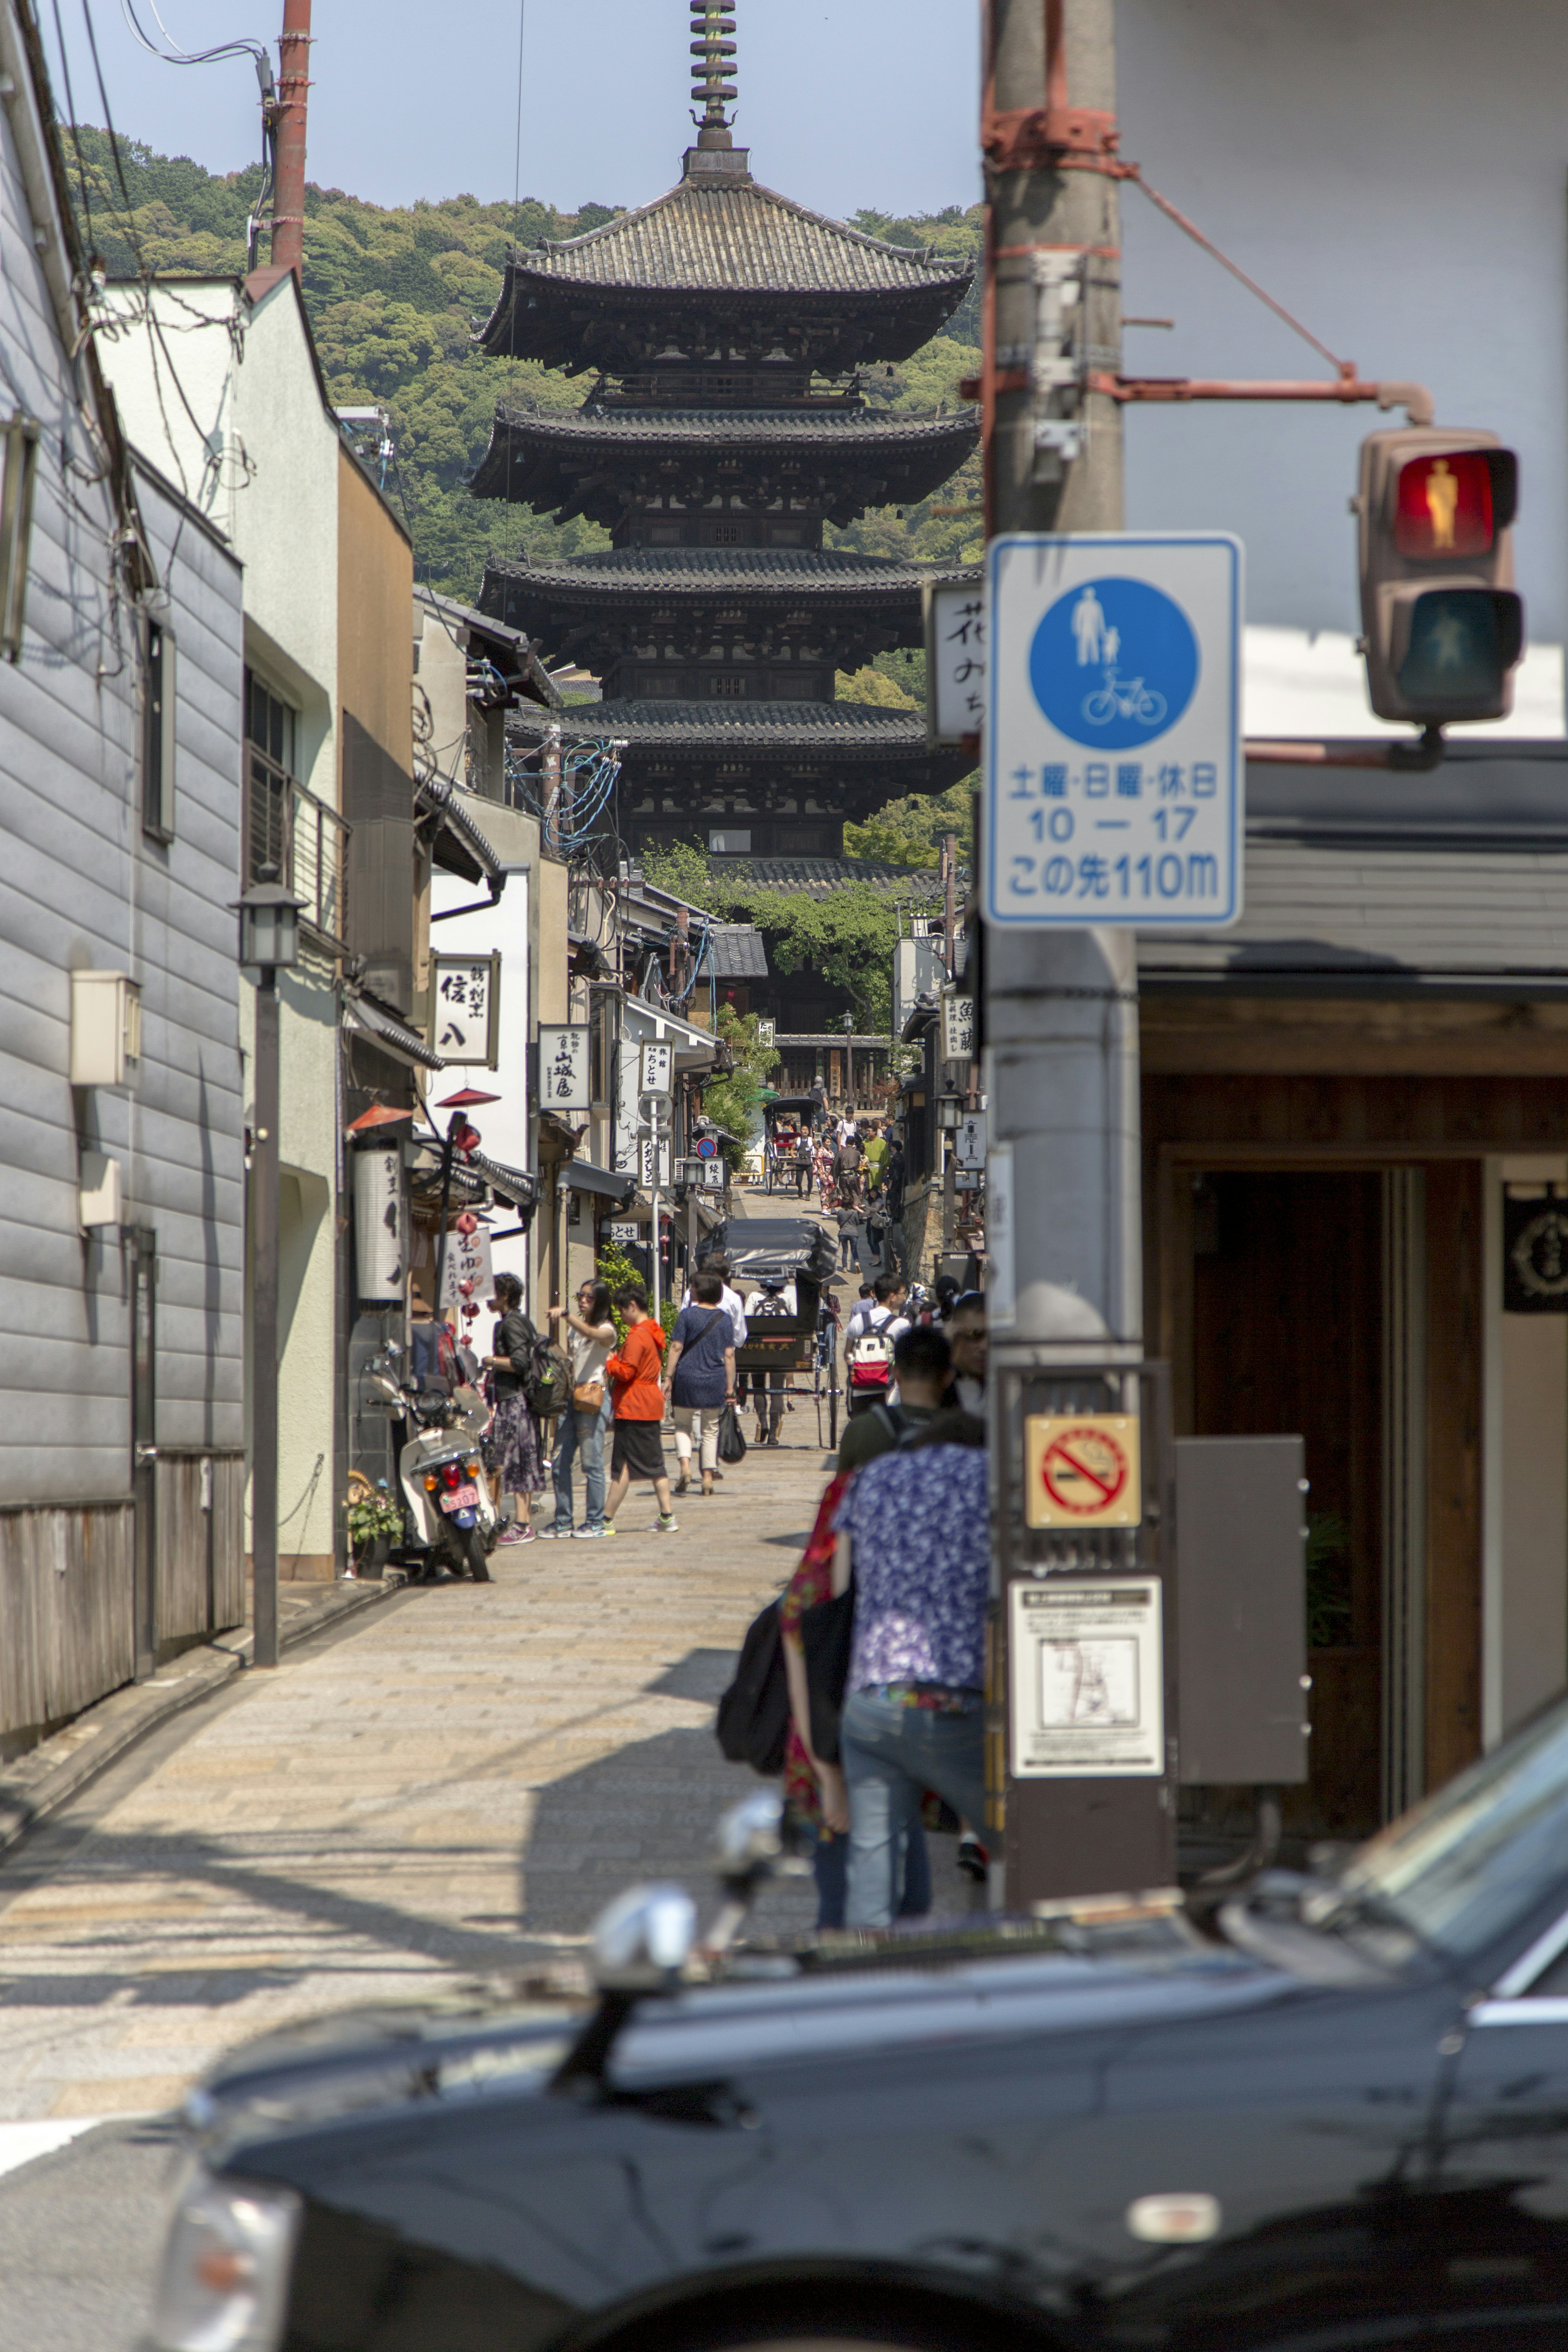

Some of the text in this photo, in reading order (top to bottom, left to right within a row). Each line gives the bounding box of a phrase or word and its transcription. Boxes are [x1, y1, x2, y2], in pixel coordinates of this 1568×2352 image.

[1009, 762, 1216, 798] 土曜・日曜・休日
[1029, 806, 1076, 844] 10
[1152, 806, 1198, 843] 17
[1009, 853, 1219, 899] この先110m
[438, 974, 468, 1047] 信八
[646, 1054, 657, 1085] ちとせ
[659, 1048, 667, 1068] 旅館
